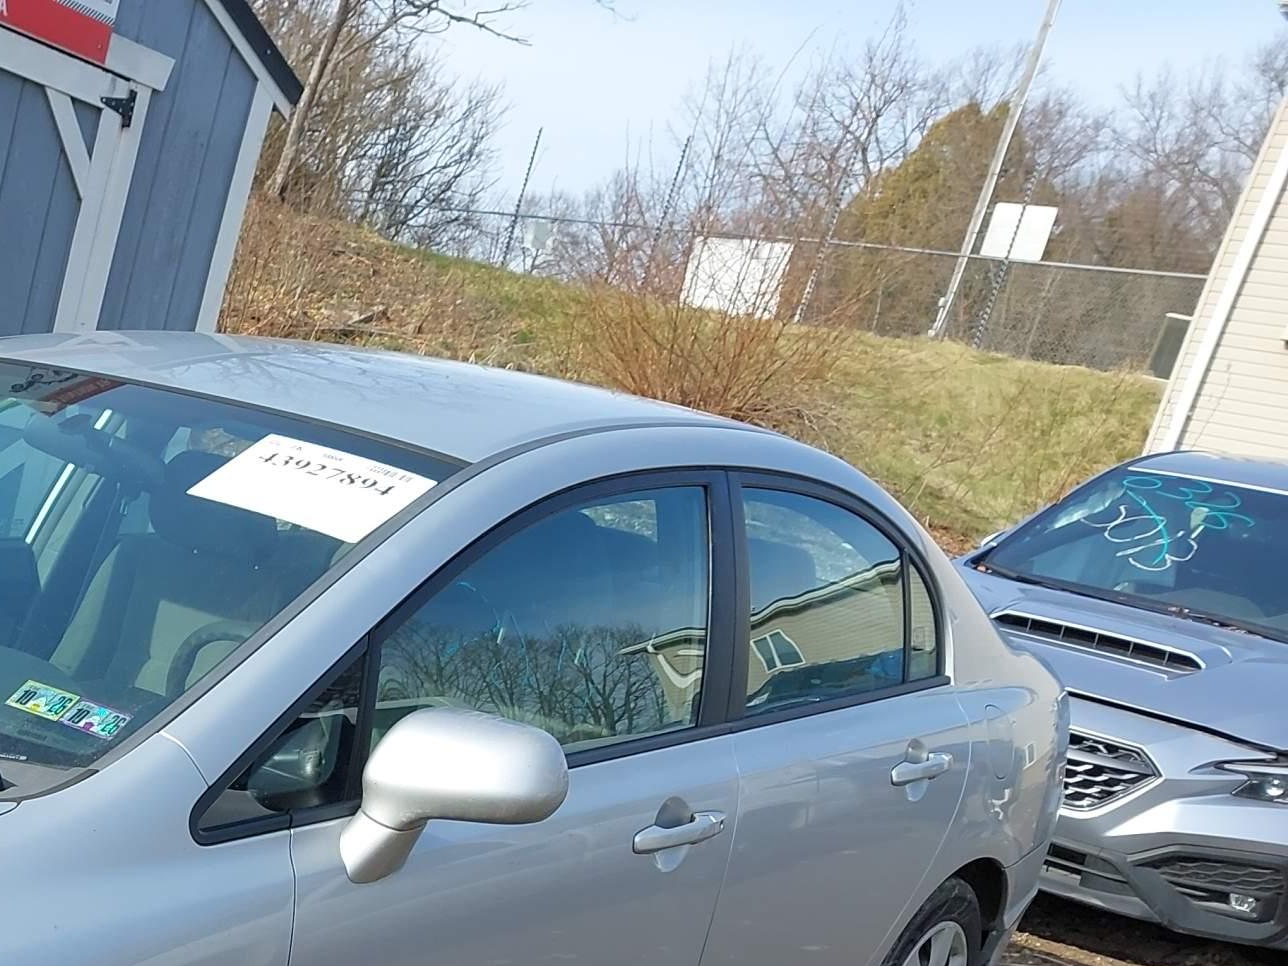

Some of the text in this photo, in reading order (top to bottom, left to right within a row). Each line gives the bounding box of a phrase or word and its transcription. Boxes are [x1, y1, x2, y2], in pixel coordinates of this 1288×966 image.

[258, 450, 397, 497] 43927894
[15, 689, 38, 706] 10
[47, 695, 73, 716] 26
[67, 707, 127, 735] 10 26
